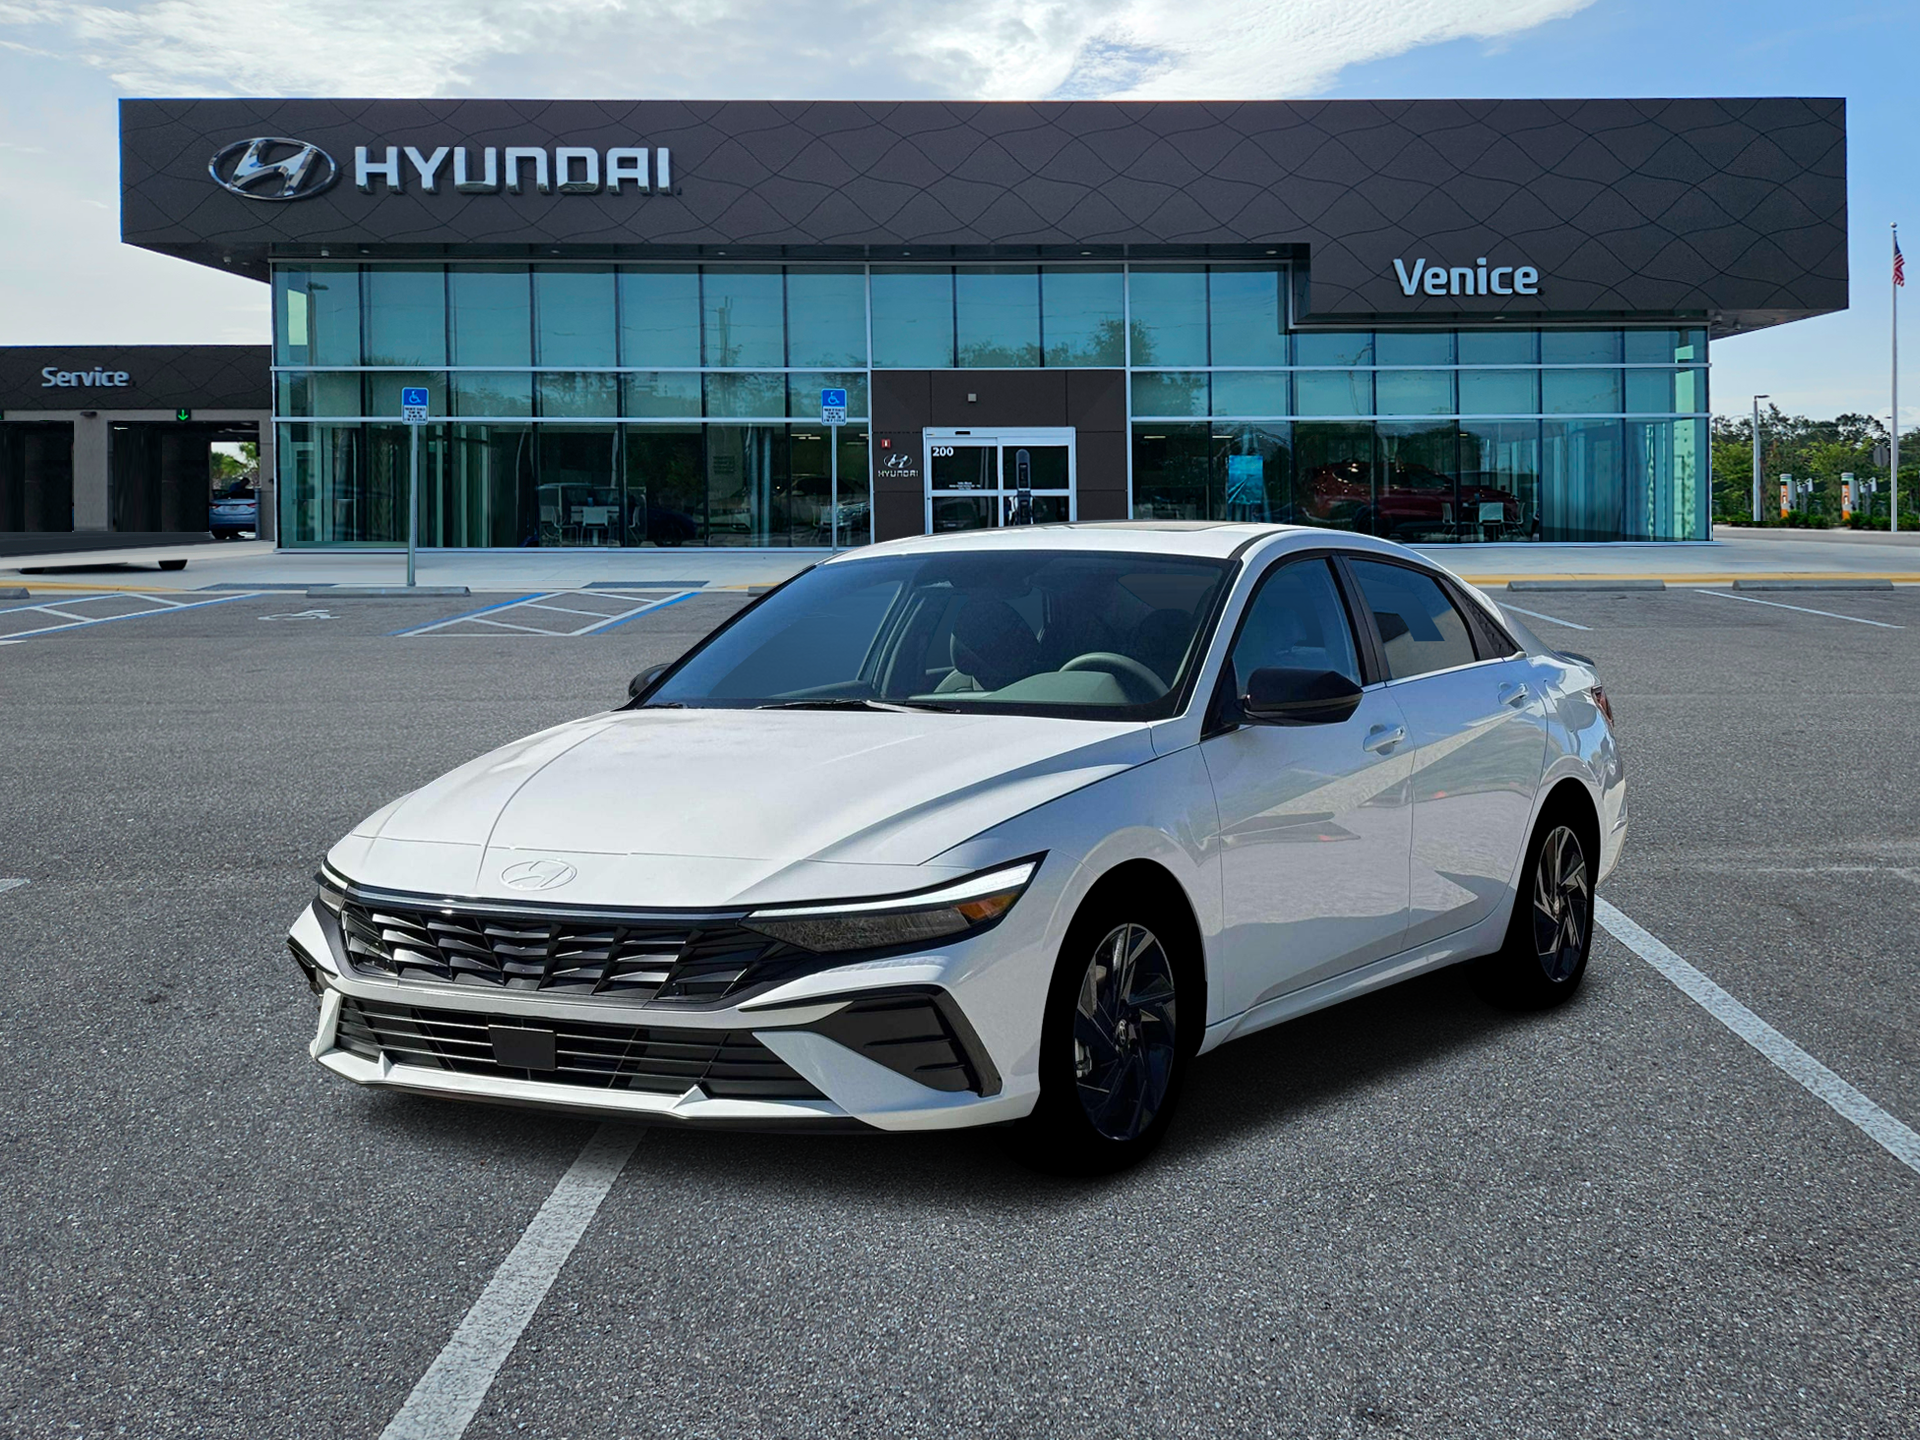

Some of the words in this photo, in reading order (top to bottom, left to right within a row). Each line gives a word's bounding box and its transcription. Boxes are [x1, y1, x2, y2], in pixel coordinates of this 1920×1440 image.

[354, 146, 671, 194] HYUNDAI
[1393, 257, 1539, 295] Venice
[41, 367, 130, 387] Service
[932, 446, 954, 457] 200
